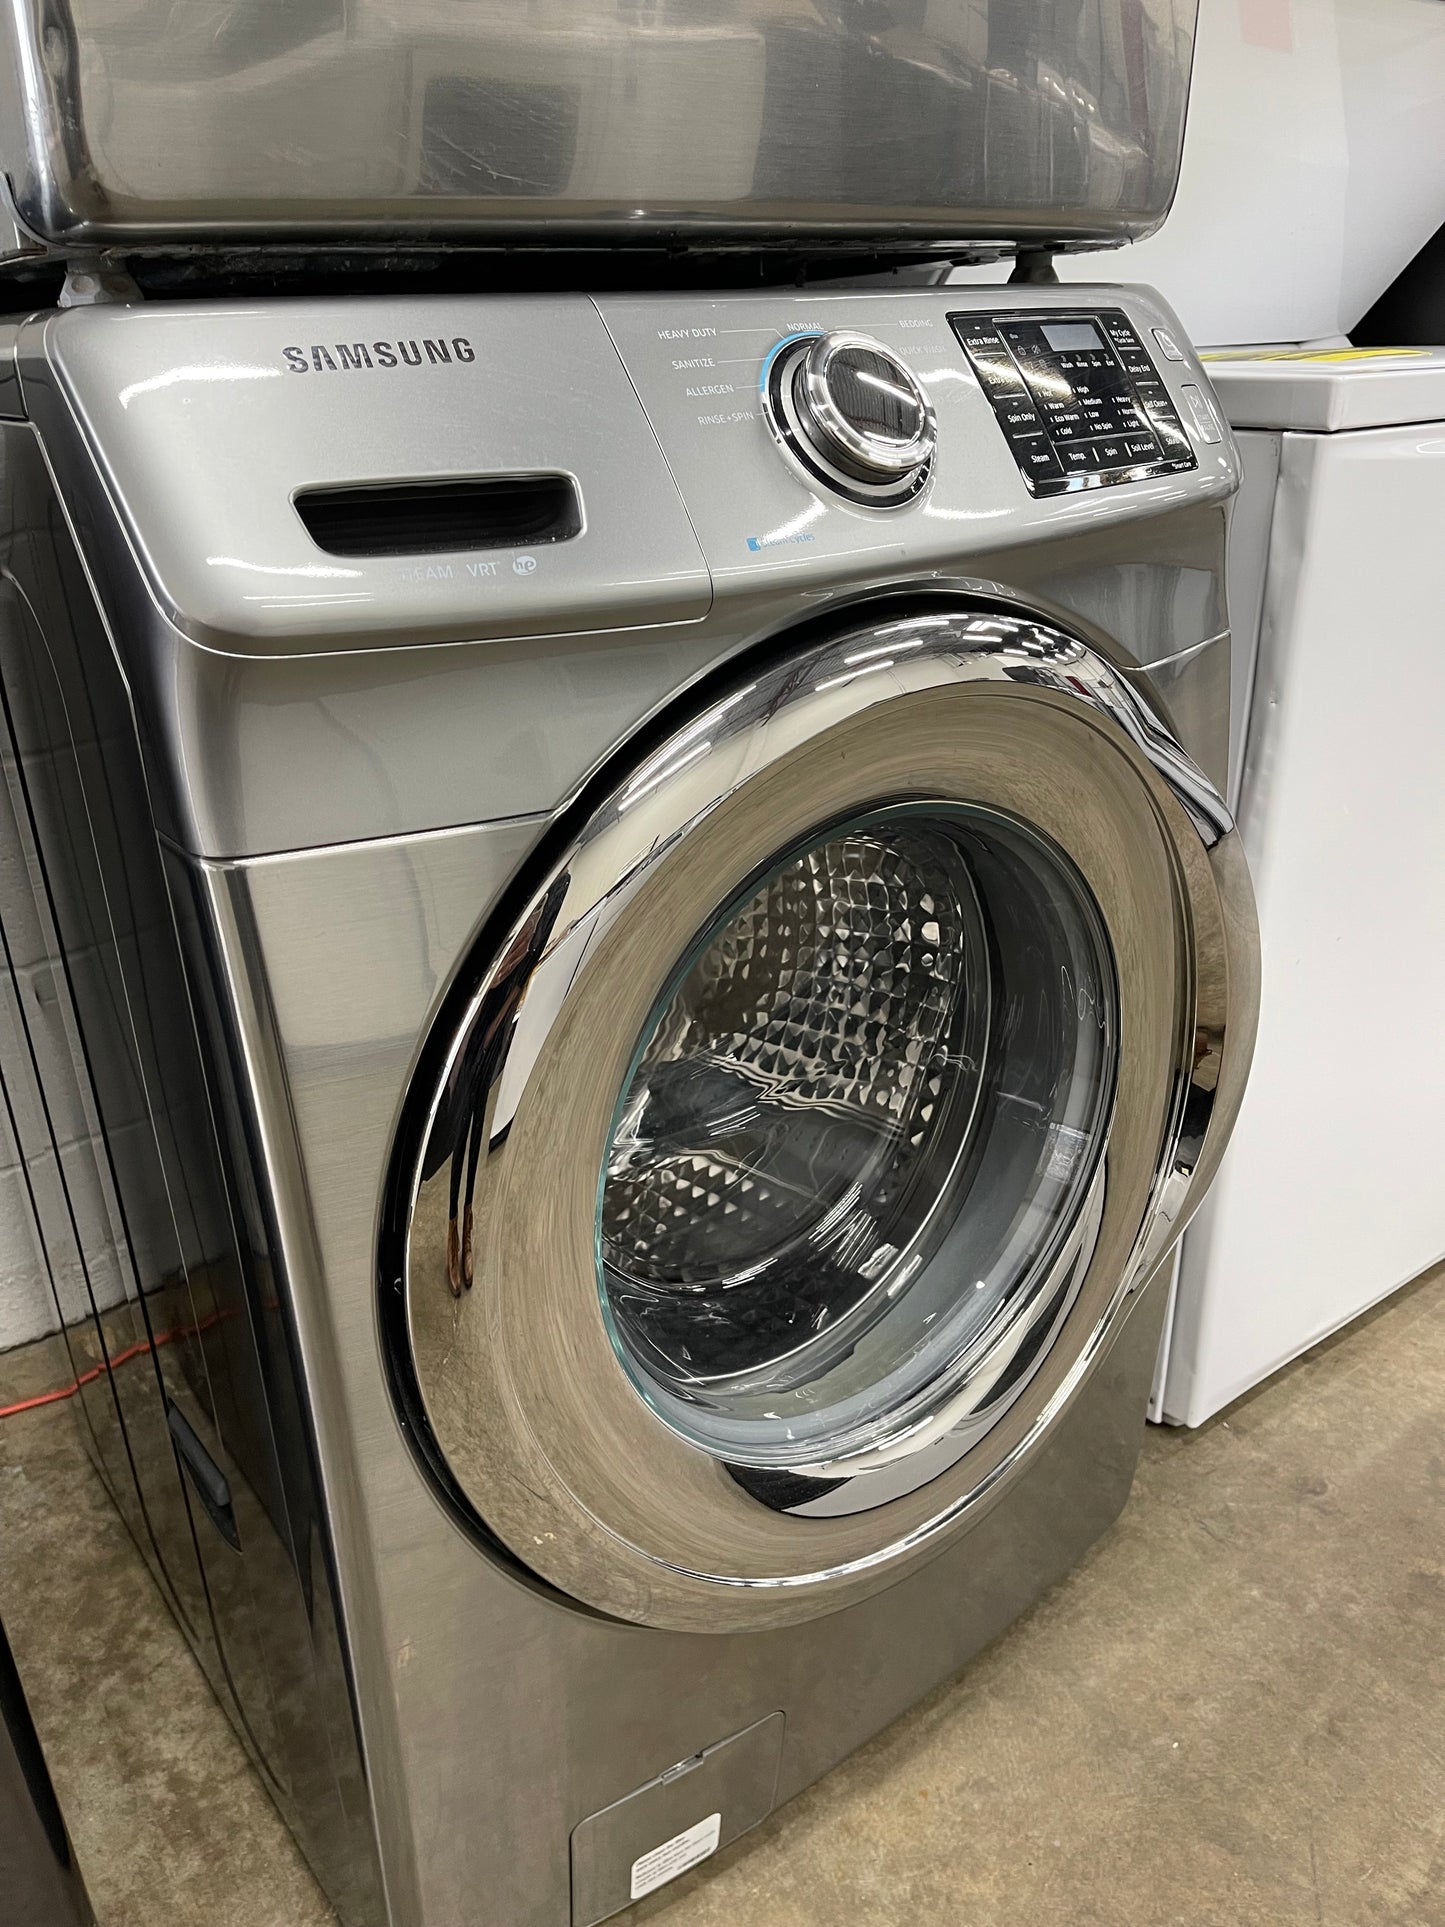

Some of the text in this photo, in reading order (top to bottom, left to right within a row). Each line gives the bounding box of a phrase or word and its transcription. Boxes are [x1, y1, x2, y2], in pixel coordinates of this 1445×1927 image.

[786, 322, 824, 332] NORMAL
[899, 319, 934, 328] BEDDING
[657, 327, 718, 340] HEAVY DUTY
[1110, 329, 1131, 337] My Cycle
[966, 336, 1000, 346] Extra Rinse
[282, 337, 476, 373] SAMSUNG
[671, 357, 716, 370] SANITIZE
[1128, 364, 1151, 373] Delay End
[685, 383, 735, 397] ALLERGEN
[1076, 385, 1090, 394] High
[1115, 396, 1131, 404] Heavy
[1048, 402, 1065, 410] Warm
[697, 410, 755, 426] RINSE+SPIN
[1008, 412, 1036, 423] Spin Only
[1054, 413, 1080, 423] Eco Warm
[1094, 422, 1114, 431] No Spin
[1126, 420, 1140, 428] Light
[1060, 427, 1073, 435] Cold
[1104, 447, 1118, 456] Spin
[1131, 442, 1155, 453] Soil Level
[1031, 454, 1050, 463] Steam
[1068, 452, 1087, 461] Temp.
